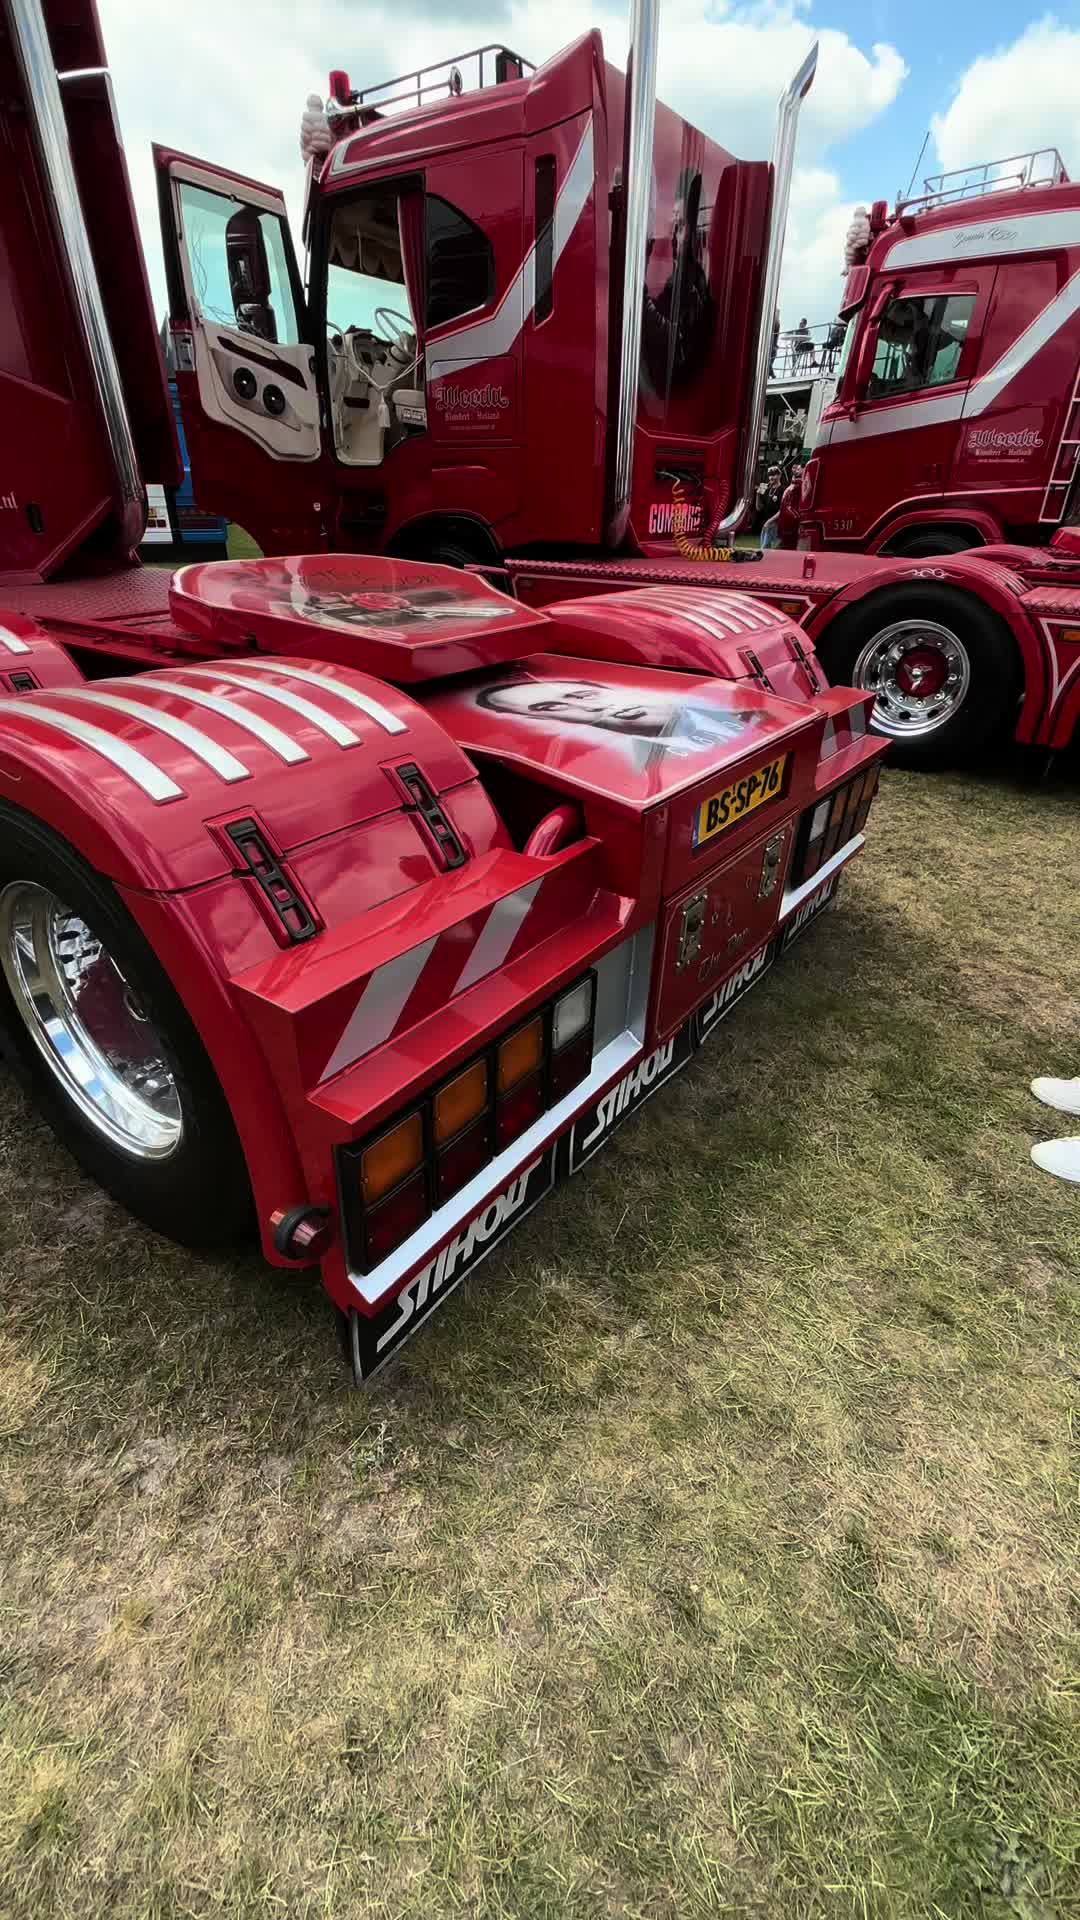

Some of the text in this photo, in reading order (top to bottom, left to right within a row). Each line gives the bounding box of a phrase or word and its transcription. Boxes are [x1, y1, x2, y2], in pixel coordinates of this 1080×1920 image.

[434, 383, 510, 410] Weeda
[967, 427, 1044, 449] Weeda
[706, 760, 780, 833] BS-SP-76
[376, 1153, 544, 1353] STIHOLT
